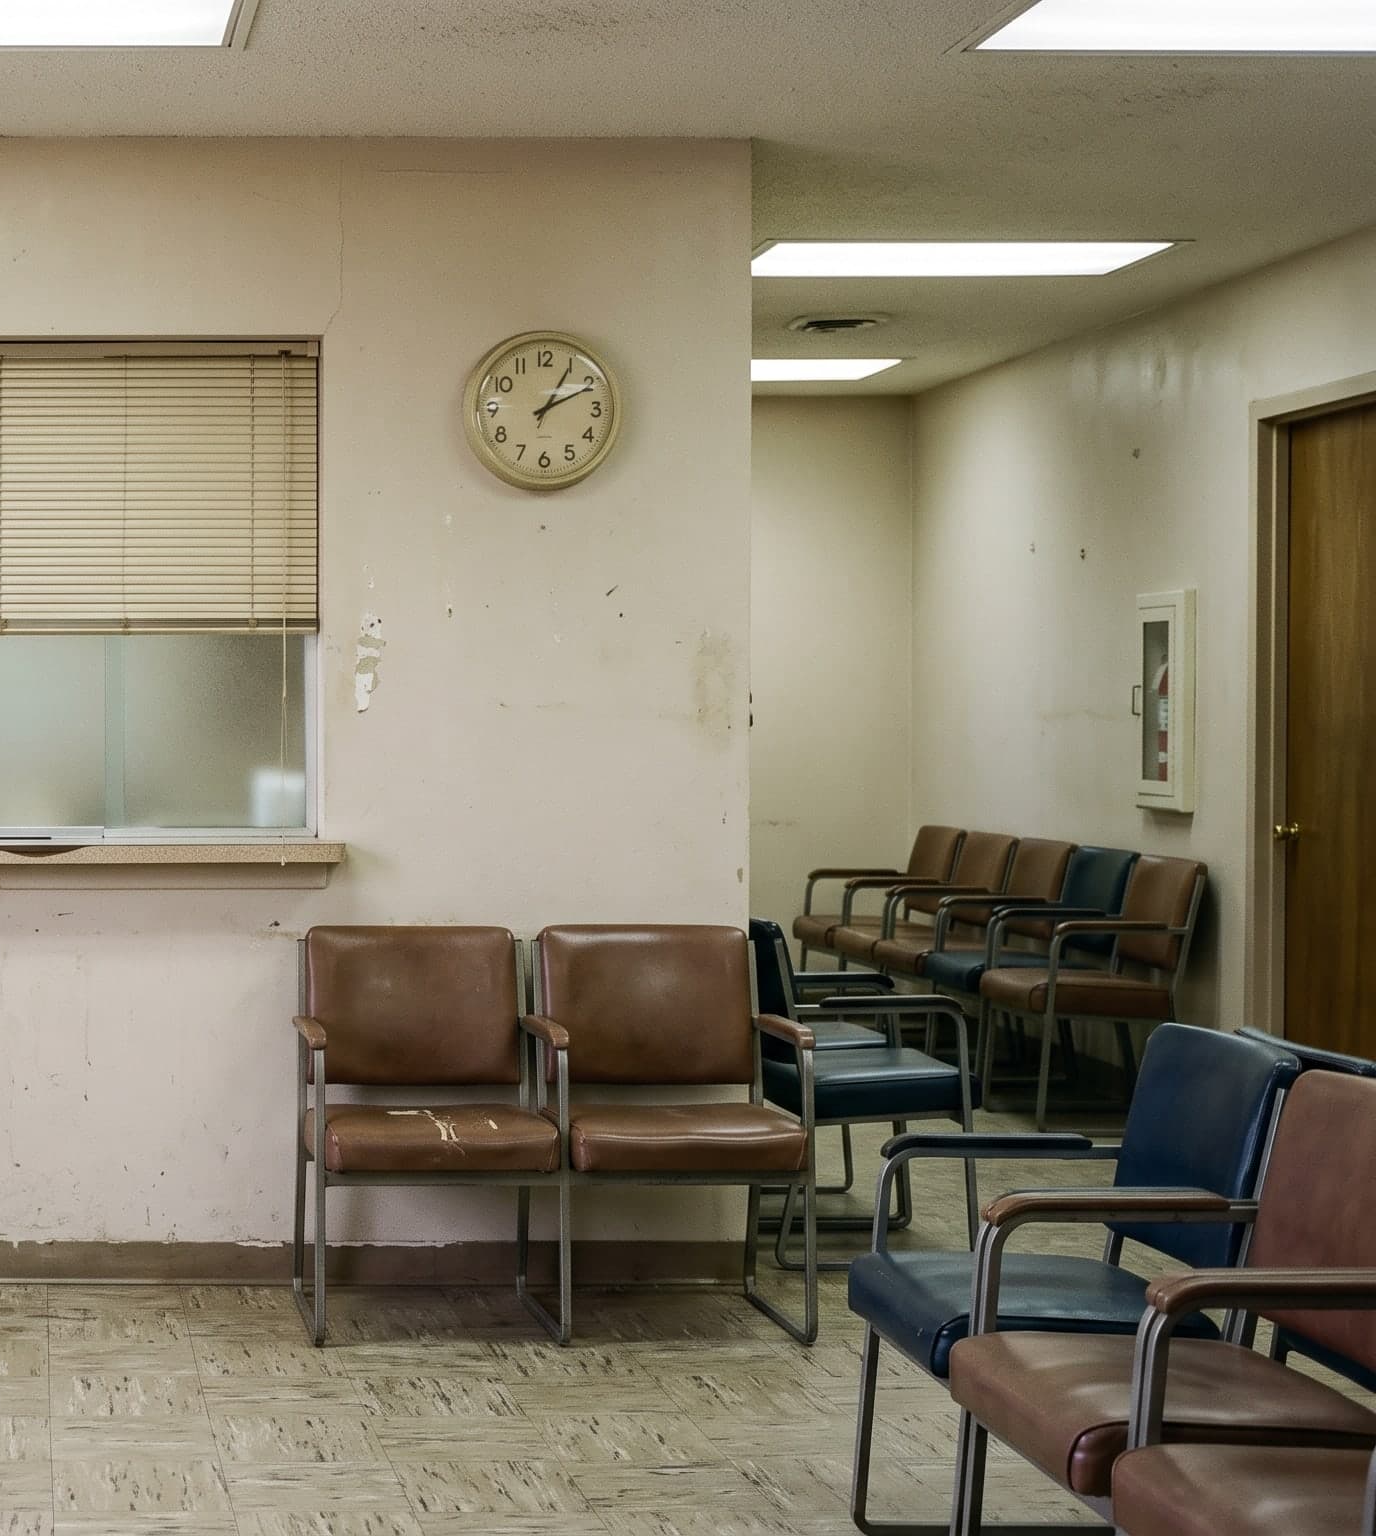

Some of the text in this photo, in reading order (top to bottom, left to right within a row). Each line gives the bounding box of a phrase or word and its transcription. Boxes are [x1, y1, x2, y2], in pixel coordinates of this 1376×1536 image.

[515, 358, 526, 374] 11
[537, 351, 553, 367] 12
[495, 376, 513, 393] 10
[583, 376, 594, 392] 2
[486, 401, 499, 418] 9
[590, 401, 602, 418] 3
[495, 426, 507, 443] 8
[582, 426, 594, 443] 4
[516, 444, 526, 461] 7
[538, 451, 551, 468] 6
[564, 444, 575, 461] 5
